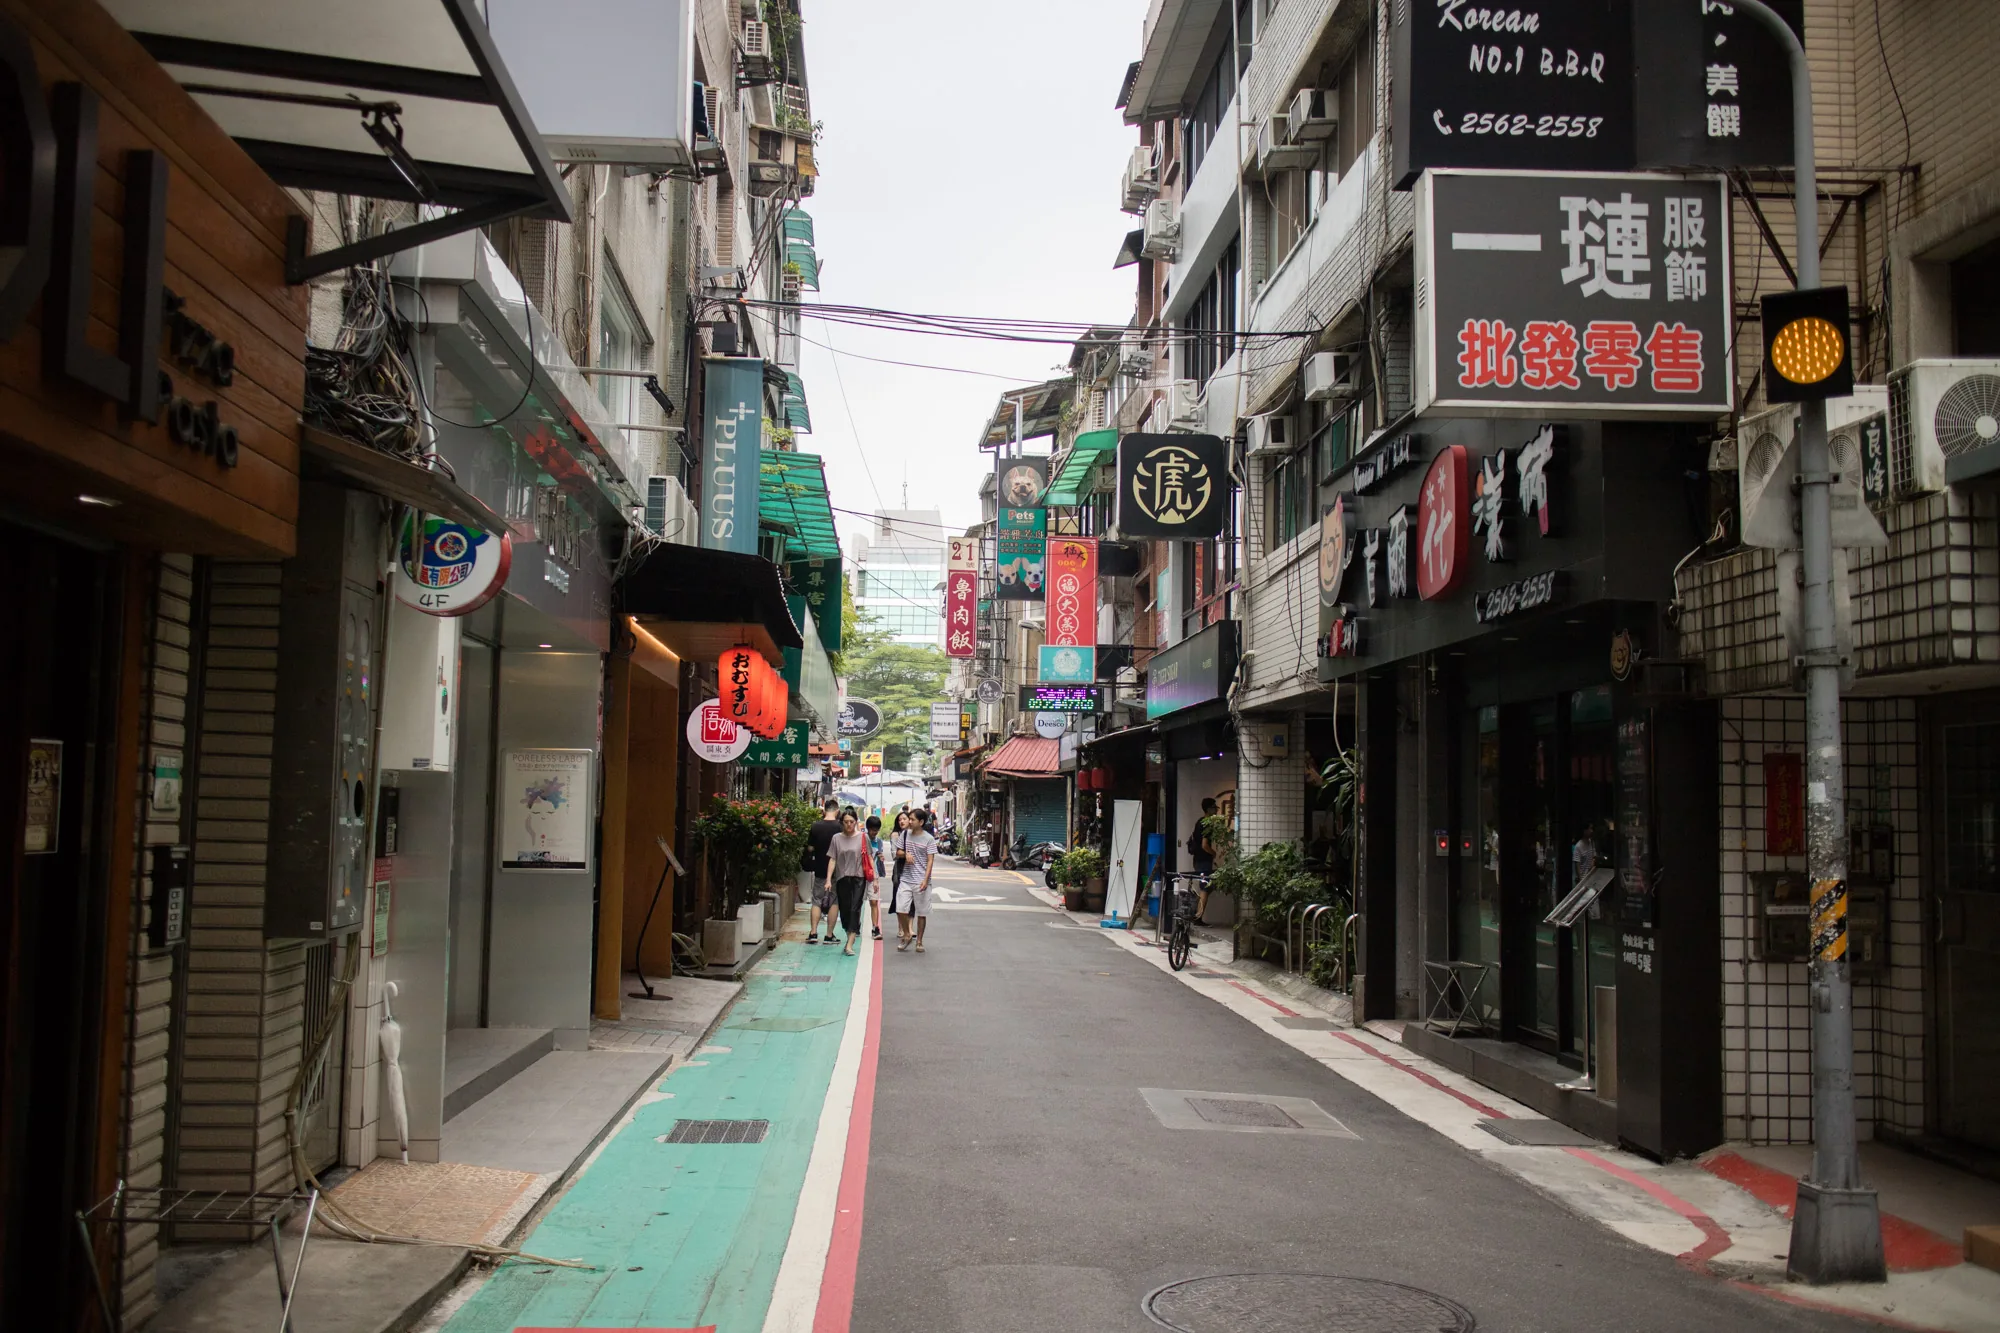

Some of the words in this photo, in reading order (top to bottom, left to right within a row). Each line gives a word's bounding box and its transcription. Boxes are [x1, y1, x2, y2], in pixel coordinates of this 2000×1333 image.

[1437, 0, 1540, 33] Korean
[1469, 44, 1524, 75] NO.1
[1460, 112, 1604, 138] 2562-2558
[1663, 196, 1707, 302] 服飾
[1458, 319, 1705, 393] 批發零售
[711, 414, 737, 539] PLUS
[1866, 422, 1886, 497] 良峰
[1155, 452, 1193, 512] 虎
[1008, 509, 1035, 520] Pets
[951, 540, 974, 561] 21
[419, 593, 450, 607] 4F
[949, 577, 973, 651] 魯肉飯
[1486, 569, 1556, 621] 2562-2558
[731, 652, 750, 717] おむすび
[1037, 720, 1064, 728] Deesco
[744, 752, 802, 763] 人間茶館
